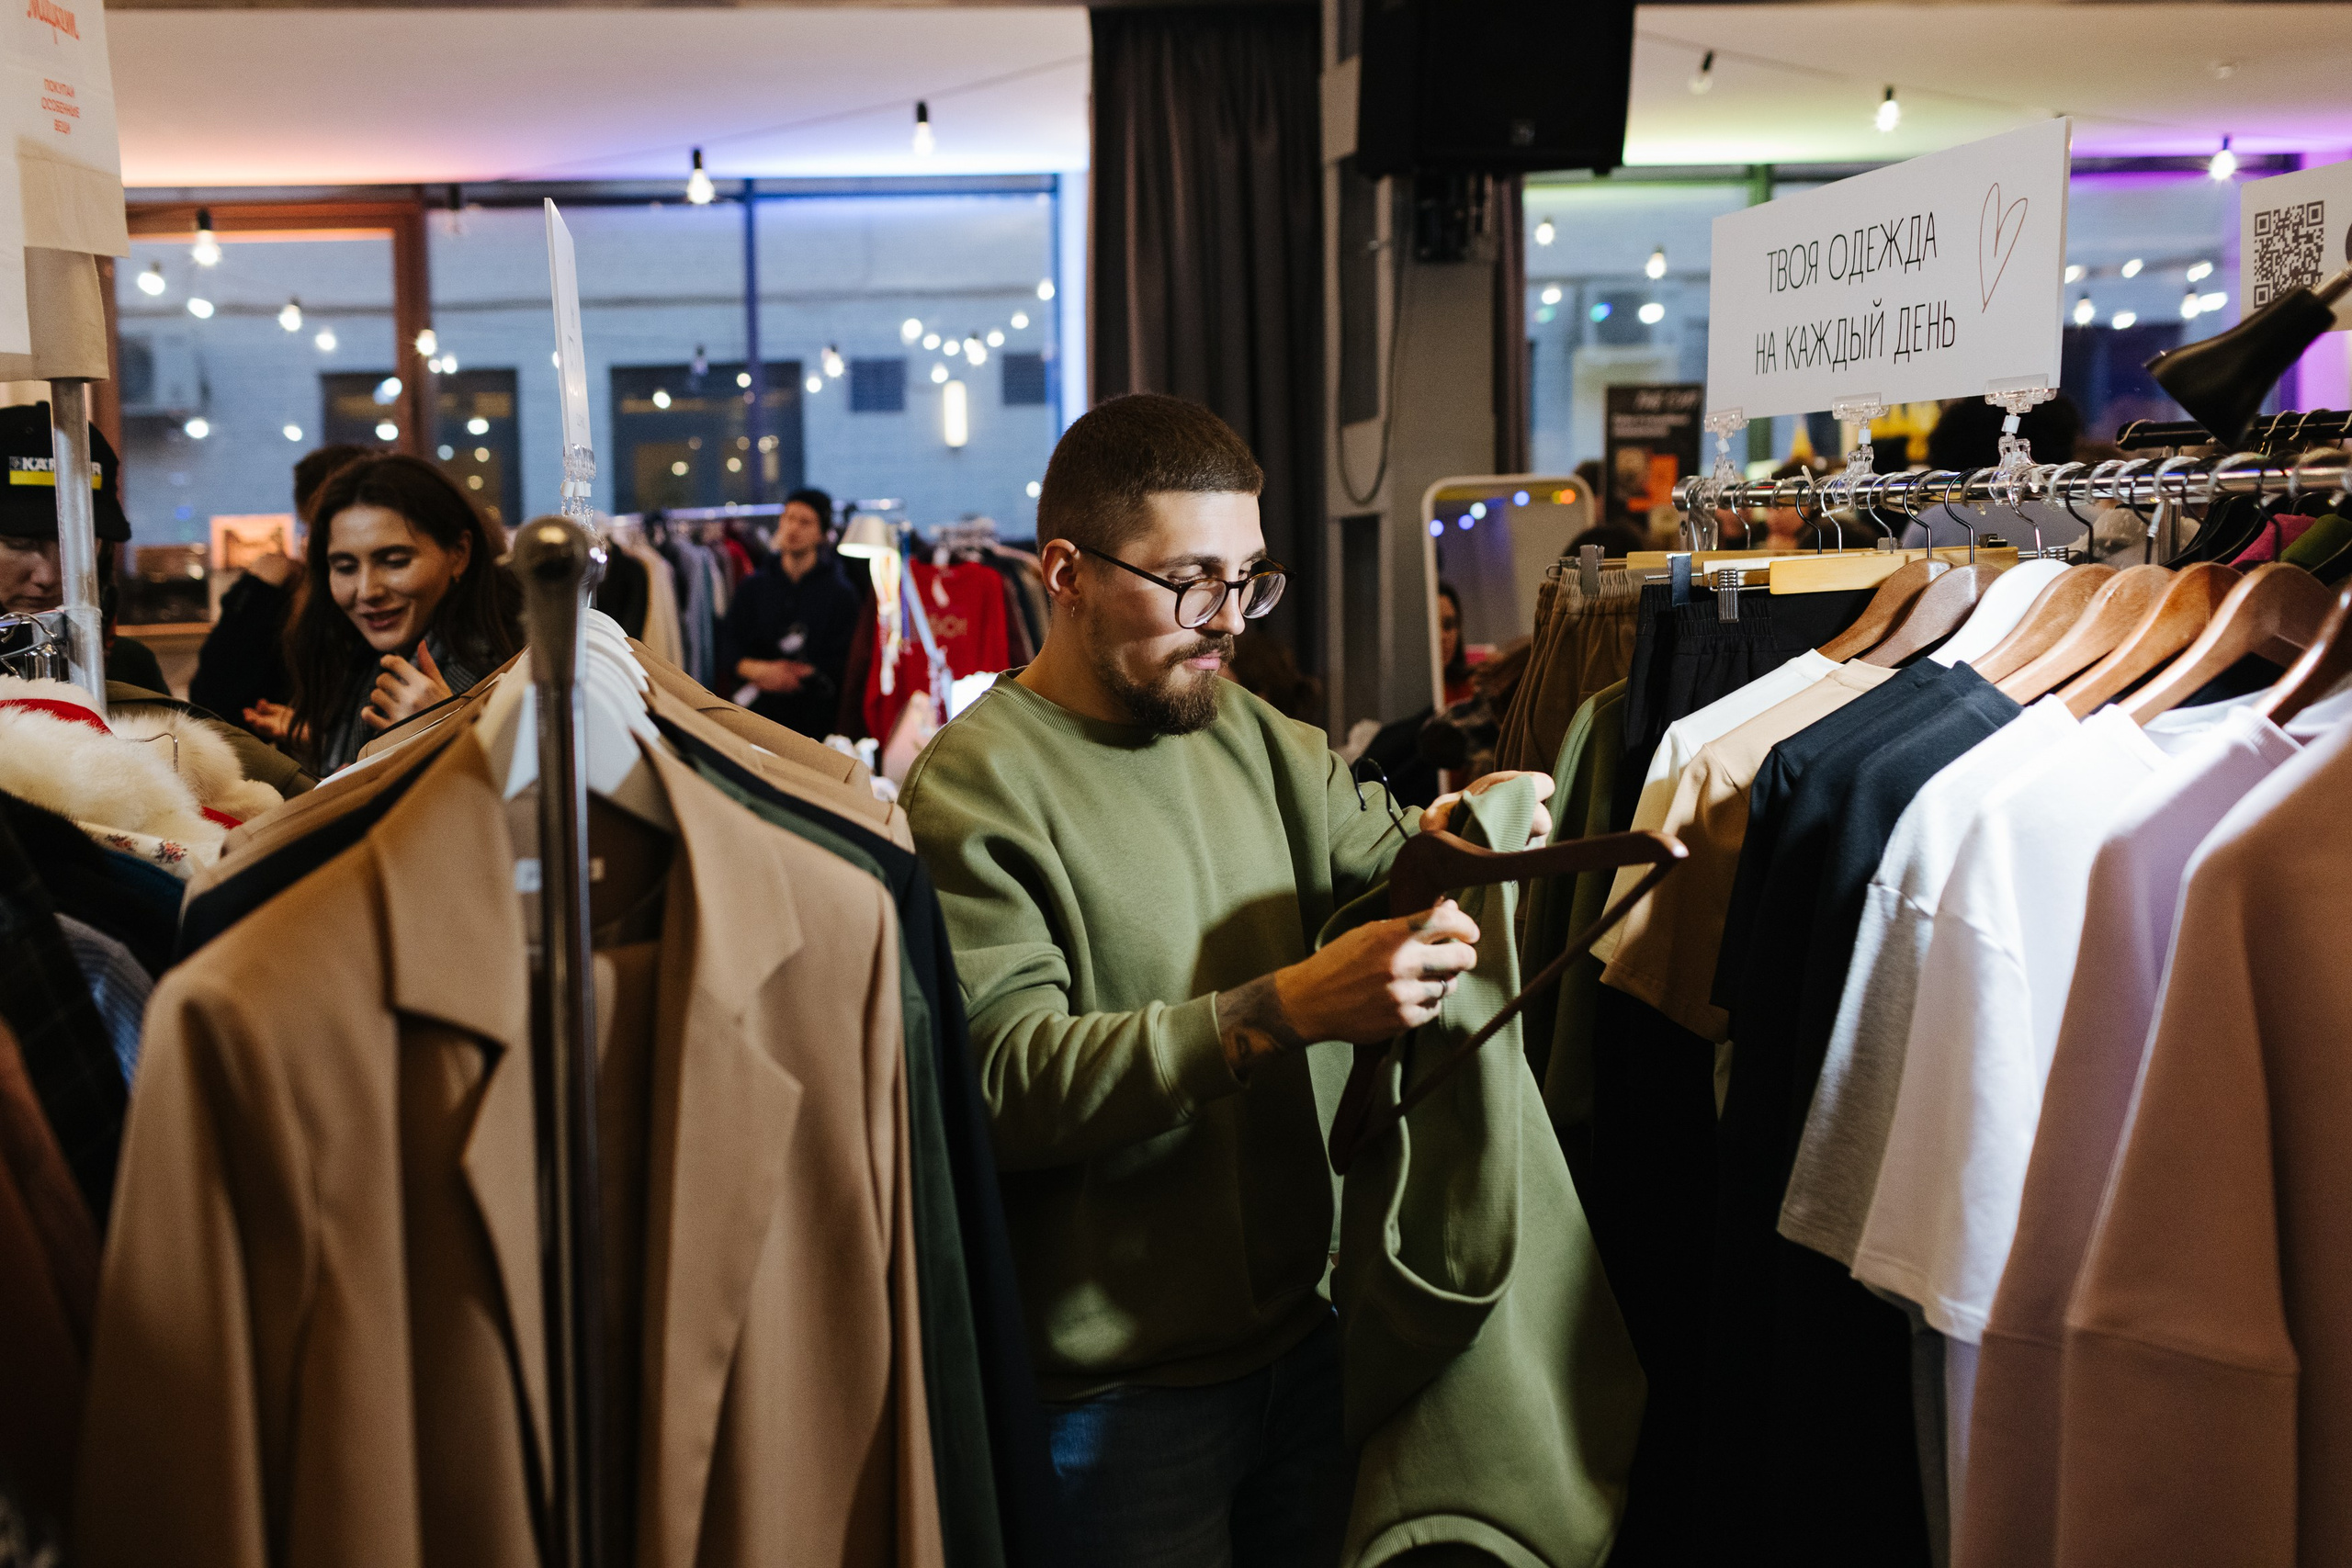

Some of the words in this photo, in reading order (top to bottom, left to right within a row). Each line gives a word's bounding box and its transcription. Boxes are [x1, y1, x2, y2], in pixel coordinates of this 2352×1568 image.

[1767, 241, 1818, 293] ТВОЯ
[1828, 211, 1937, 286] ОДЕЖДА
[1756, 331, 1777, 375] НА
[1785, 297, 1884, 373] КАЖДЫЙ
[1894, 299, 1956, 365] ДЕНЬ
